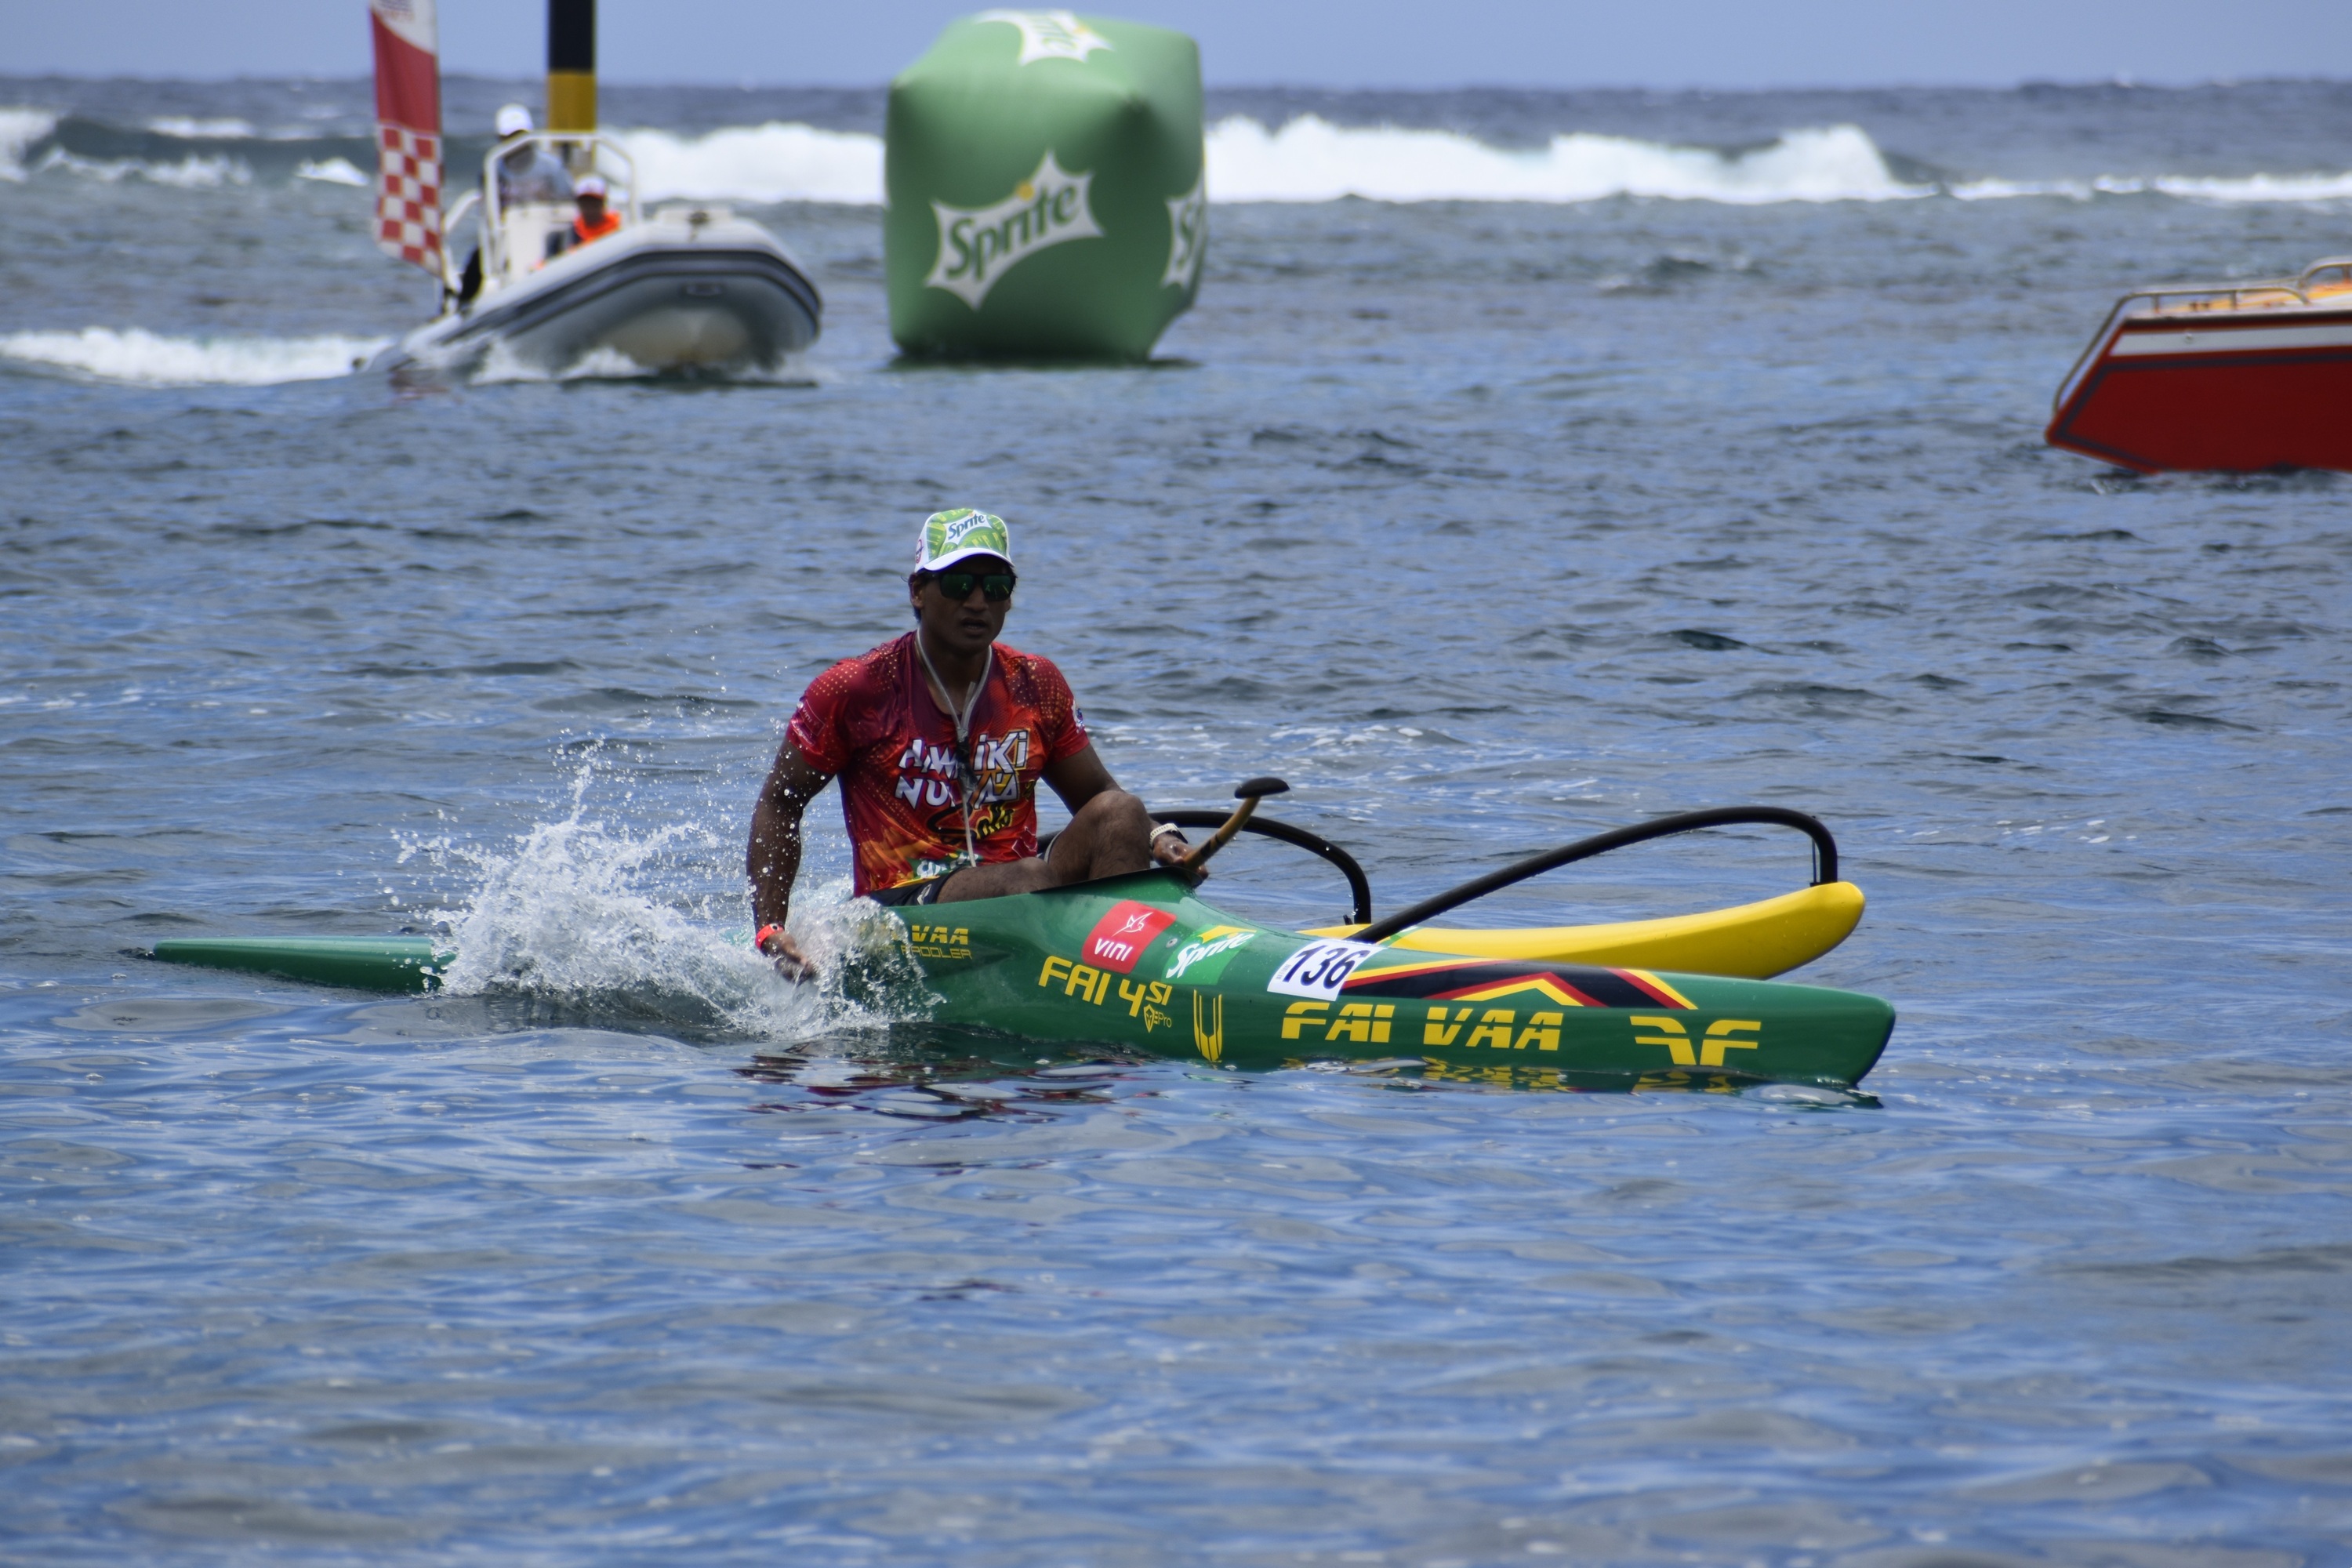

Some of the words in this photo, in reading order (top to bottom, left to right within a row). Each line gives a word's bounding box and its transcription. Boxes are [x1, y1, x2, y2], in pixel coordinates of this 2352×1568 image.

[946, 185, 1077, 281] Sprite
[947, 514, 985, 540] Sprite
[911, 924, 969, 946] VAA
[1165, 931, 1255, 979] Sprite
[1038, 955, 1112, 1006] FAI
[1282, 945, 1371, 989] 136
[1280, 1001, 1396, 1044] FAI
[1423, 1007, 1564, 1051] VAA
